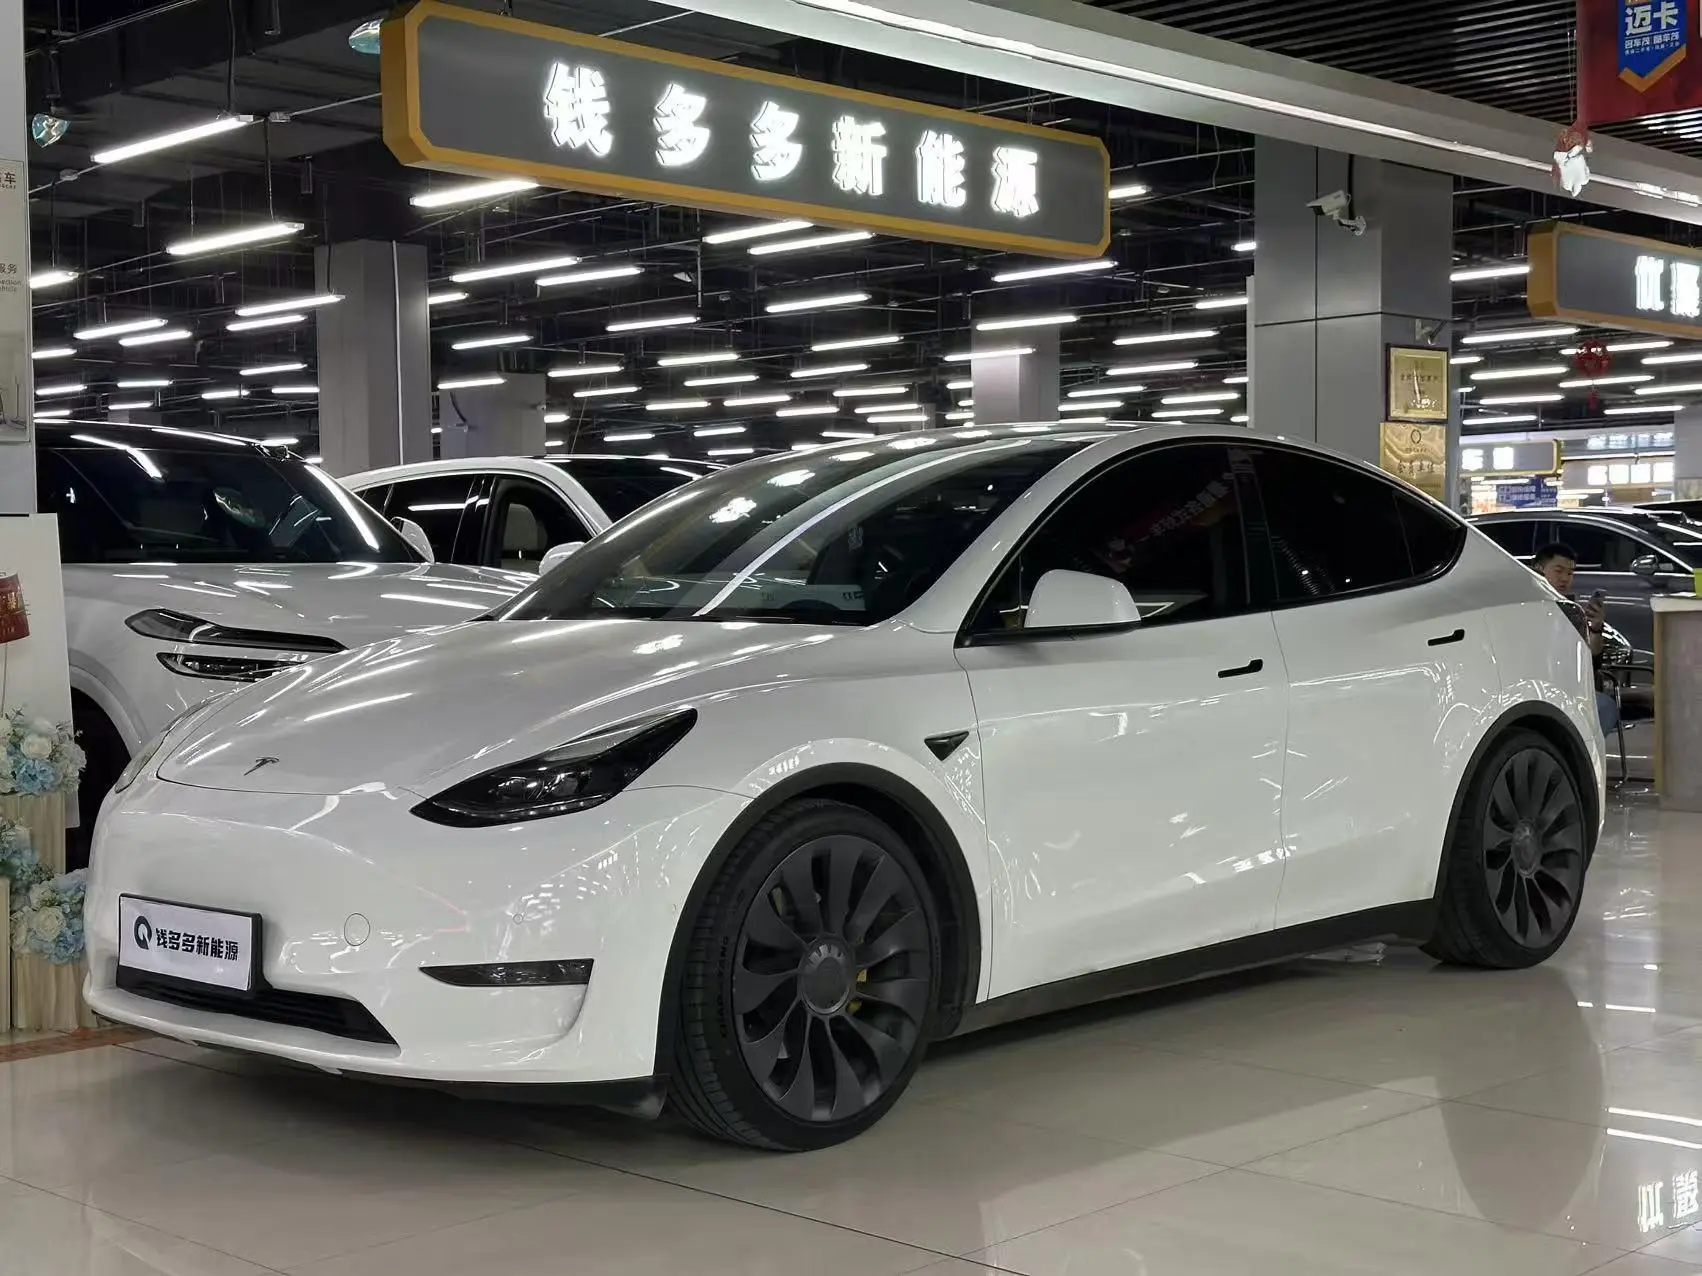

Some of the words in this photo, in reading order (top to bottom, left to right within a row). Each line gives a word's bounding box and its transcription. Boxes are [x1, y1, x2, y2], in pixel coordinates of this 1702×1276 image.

[1625, 2, 1679, 36] 迈卡
[542, 61, 1040, 218] 钱多多新能源
[155, 927, 239, 961] 钱多多新能源
